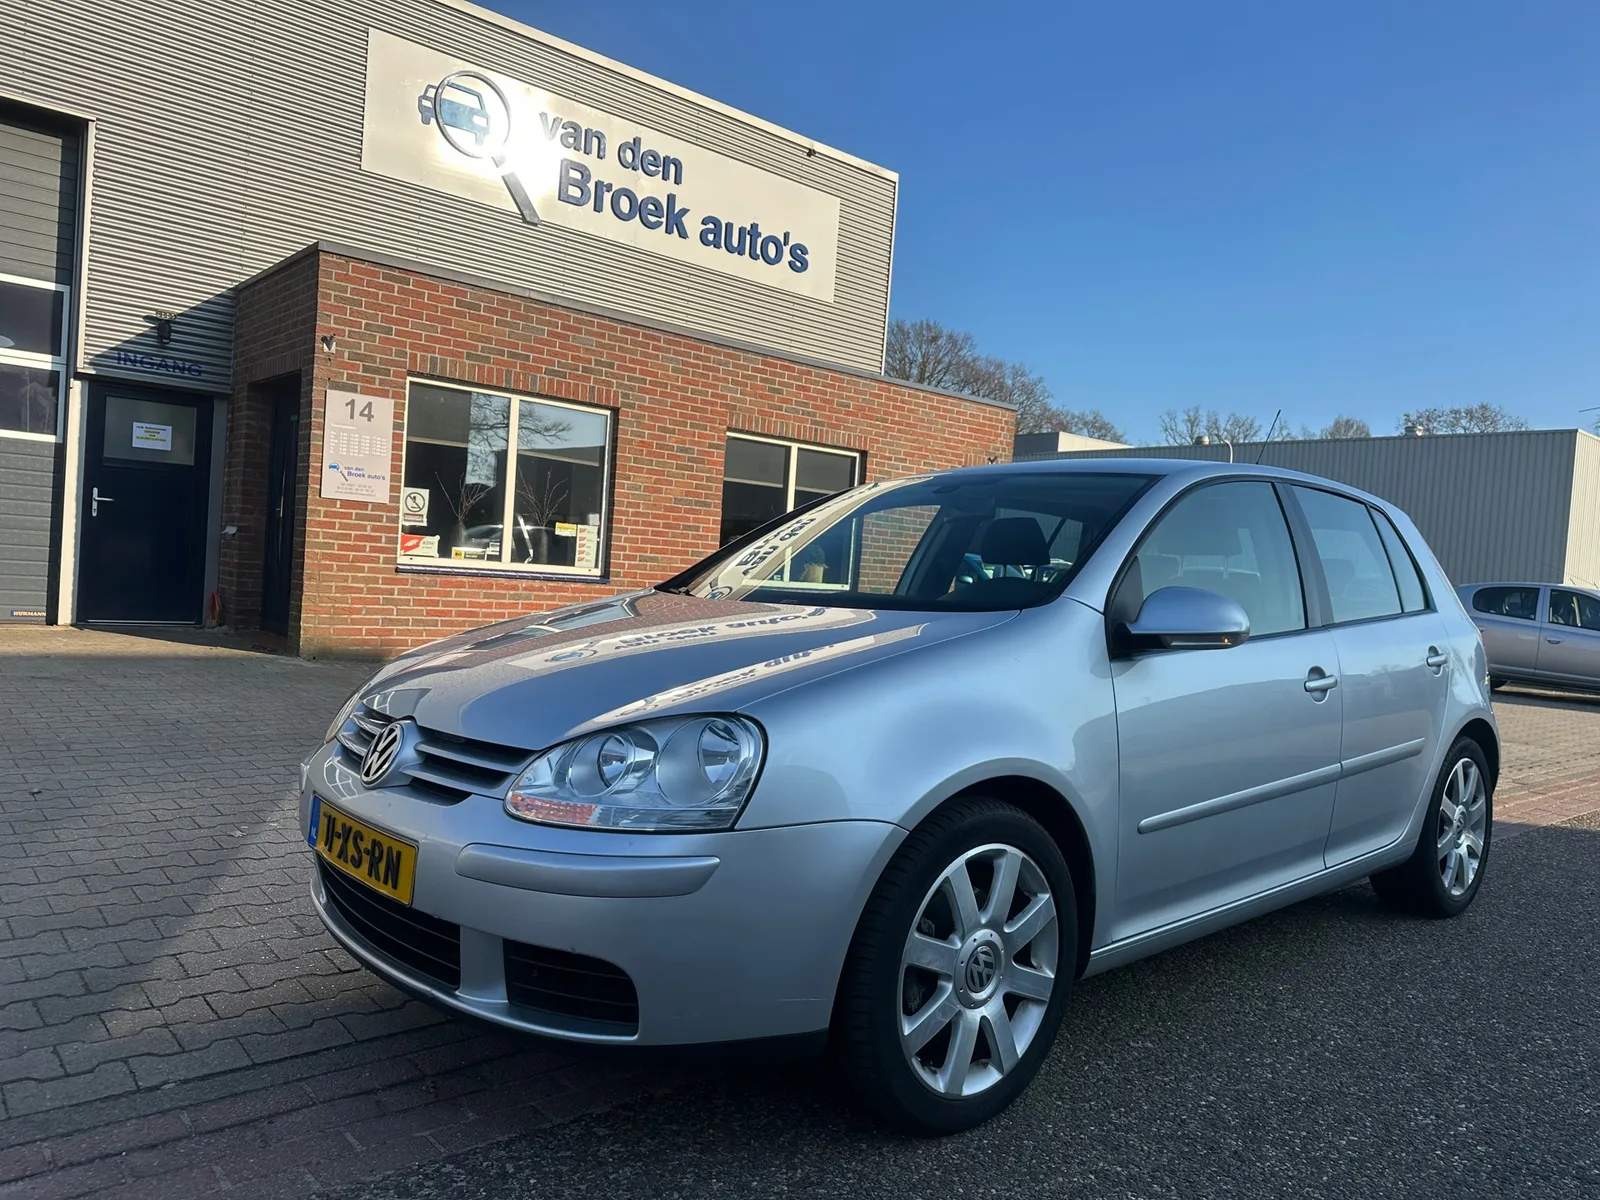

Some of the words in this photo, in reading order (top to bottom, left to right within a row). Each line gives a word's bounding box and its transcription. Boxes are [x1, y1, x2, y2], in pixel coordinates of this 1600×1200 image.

[538, 111, 606, 159] van
[617, 137, 683, 185] den
[557, 157, 691, 239] Broek
[699, 213, 809, 273] auto's
[116, 352, 202, 376] INGANG
[345, 398, 374, 422] 14
[310, 826, 317, 839] NL
[323, 811, 402, 890] 71-XS-RN
